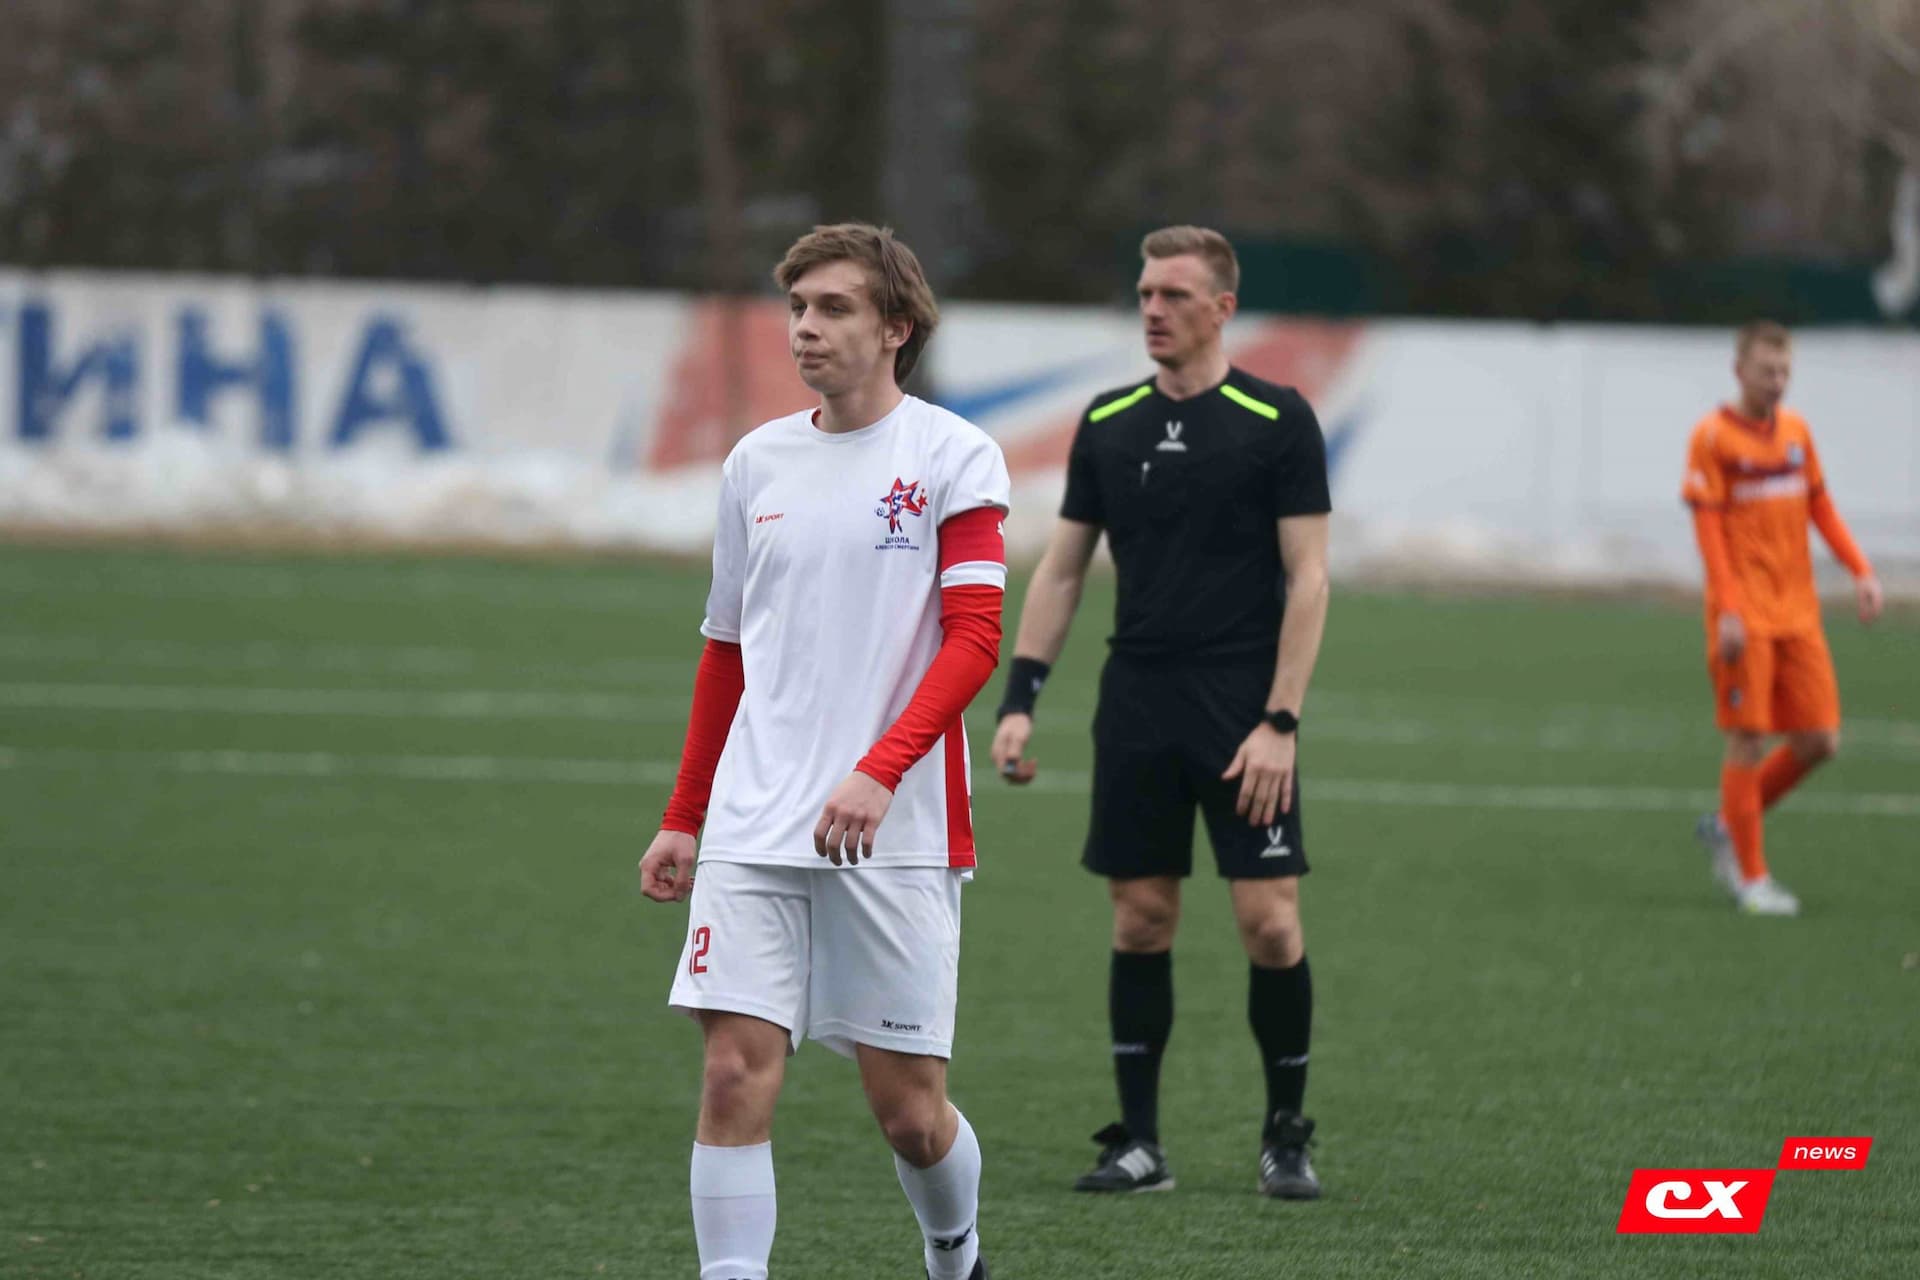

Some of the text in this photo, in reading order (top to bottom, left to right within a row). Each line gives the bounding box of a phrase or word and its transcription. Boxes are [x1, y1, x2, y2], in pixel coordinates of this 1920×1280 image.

[0, 302, 453, 451] ИНА
[885, 536, 910, 544] ШКОЛА
[895, 1023, 922, 1031] SPORT
